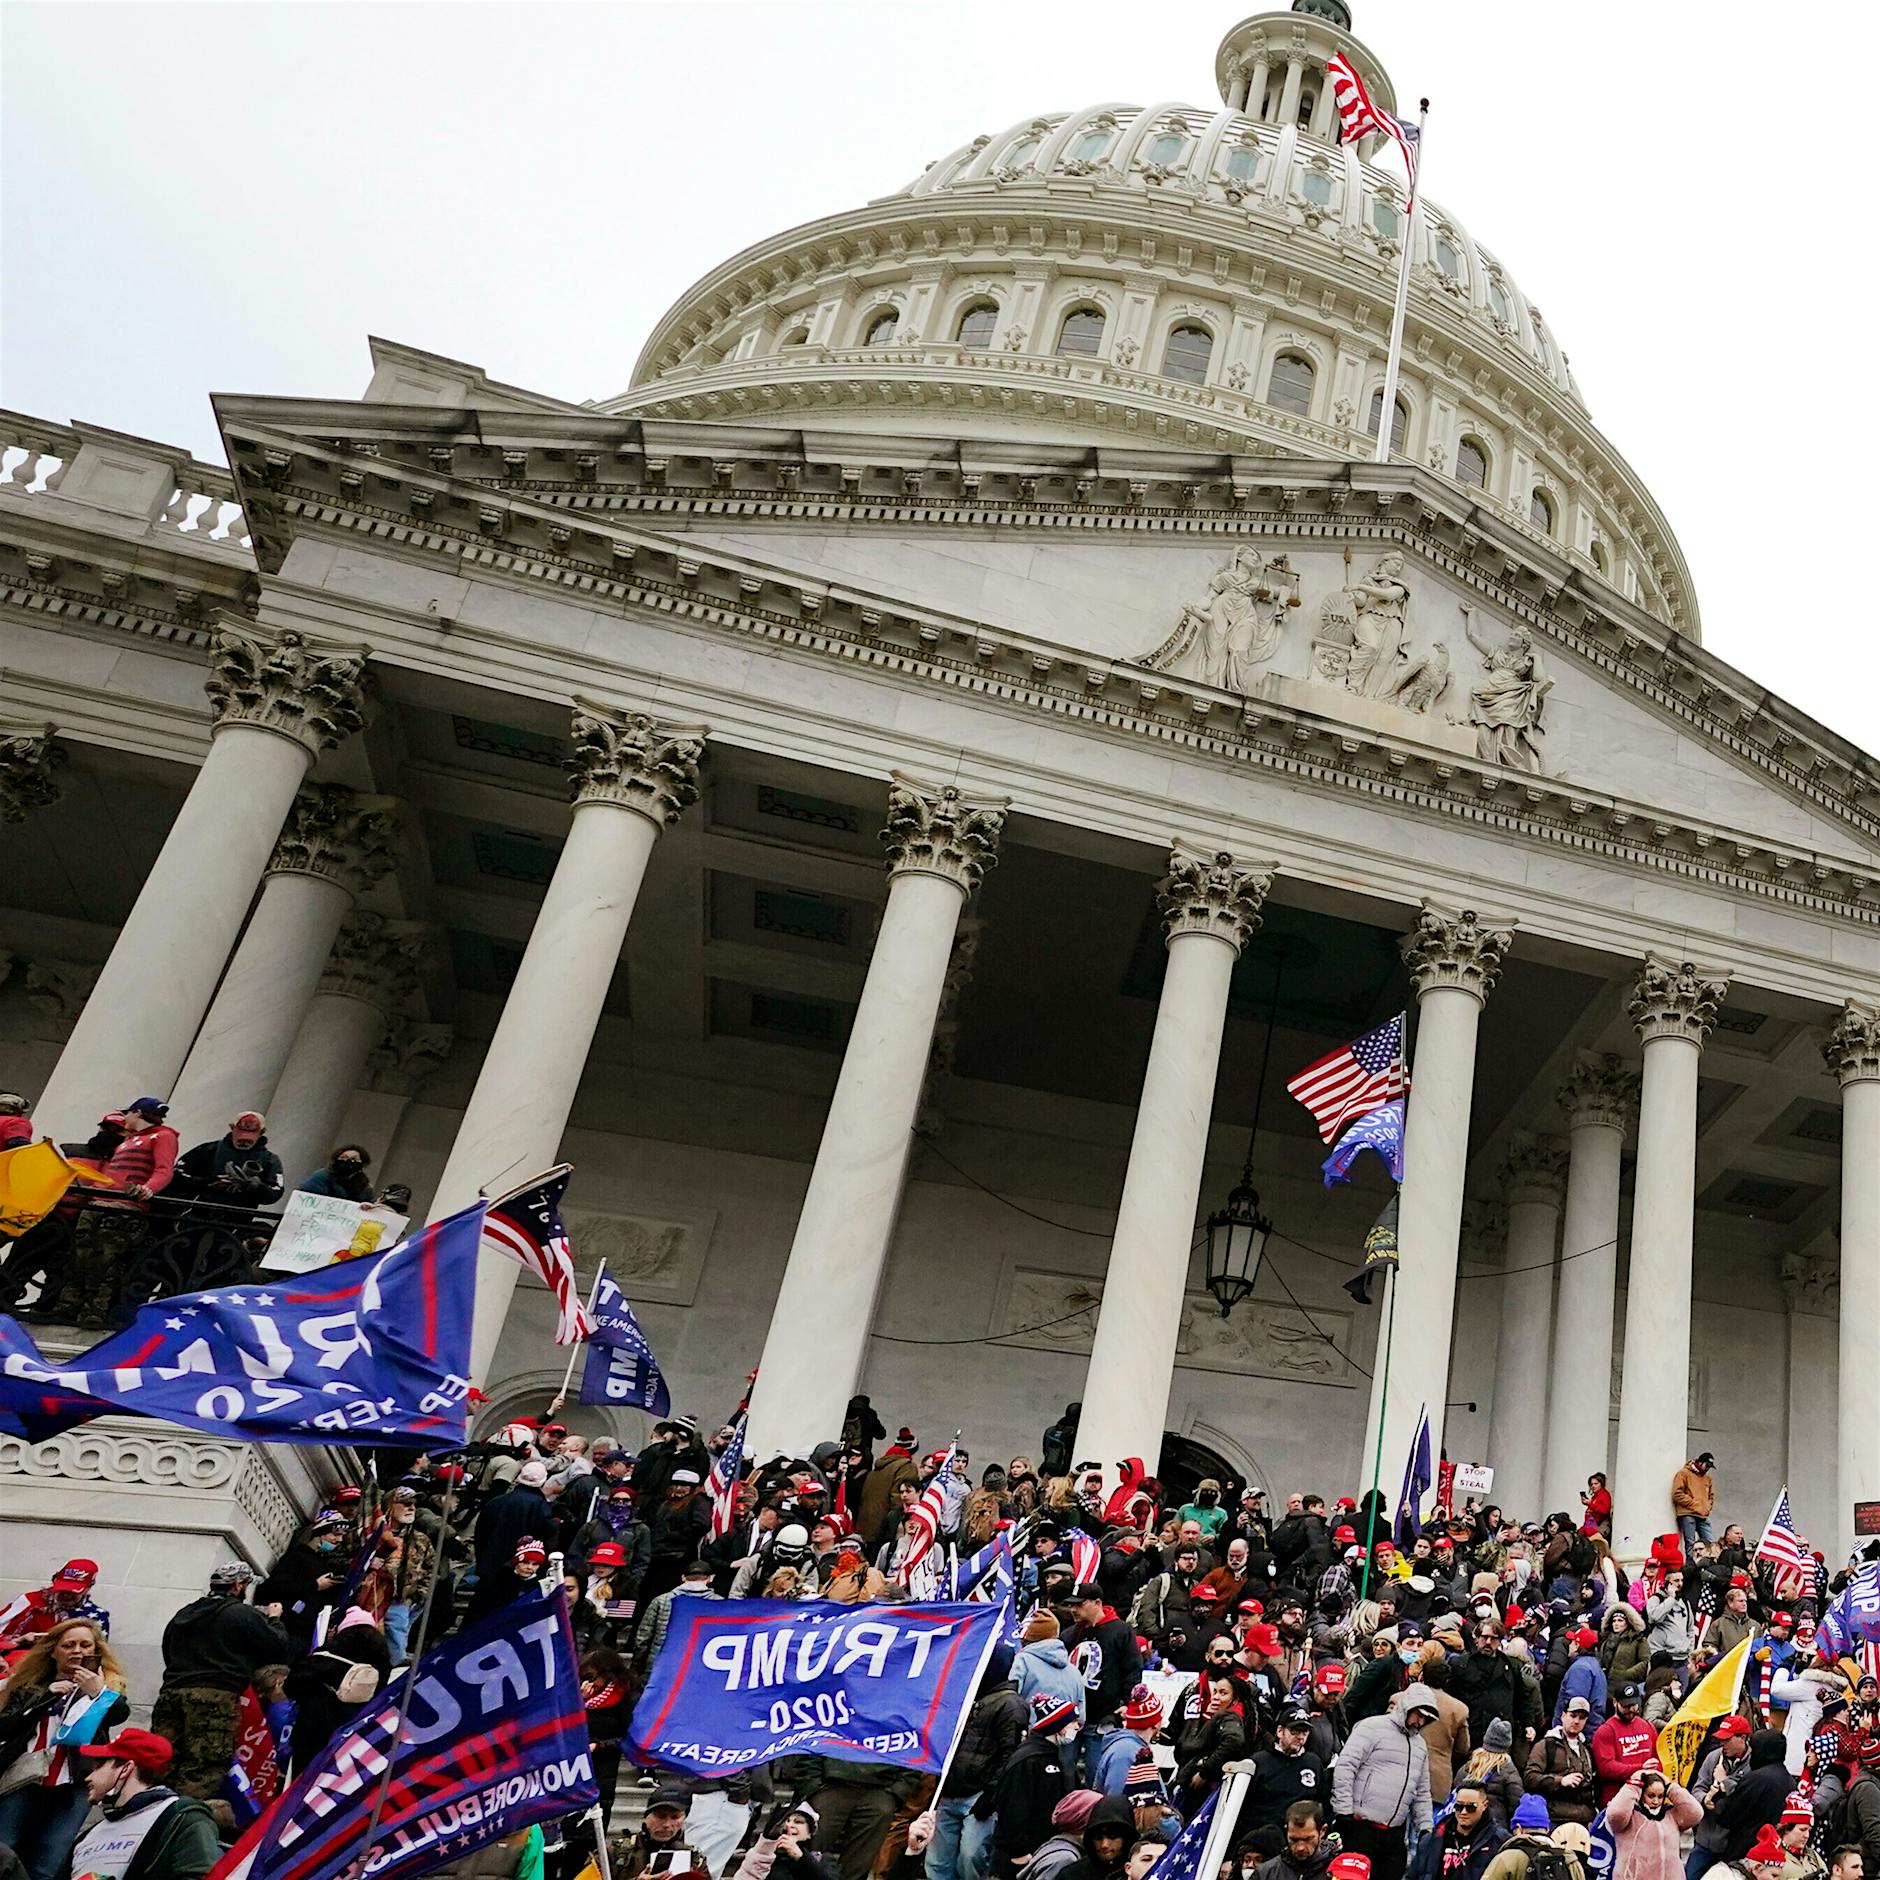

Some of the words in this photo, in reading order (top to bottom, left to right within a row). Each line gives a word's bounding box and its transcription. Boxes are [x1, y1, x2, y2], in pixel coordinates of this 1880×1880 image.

[528, 1195, 550, 1223] 76
[1464, 1467, 1486, 1477] STOP
[1459, 1479, 1485, 1489] STEAL
[1618, 1733, 1650, 1745] TRUMP
